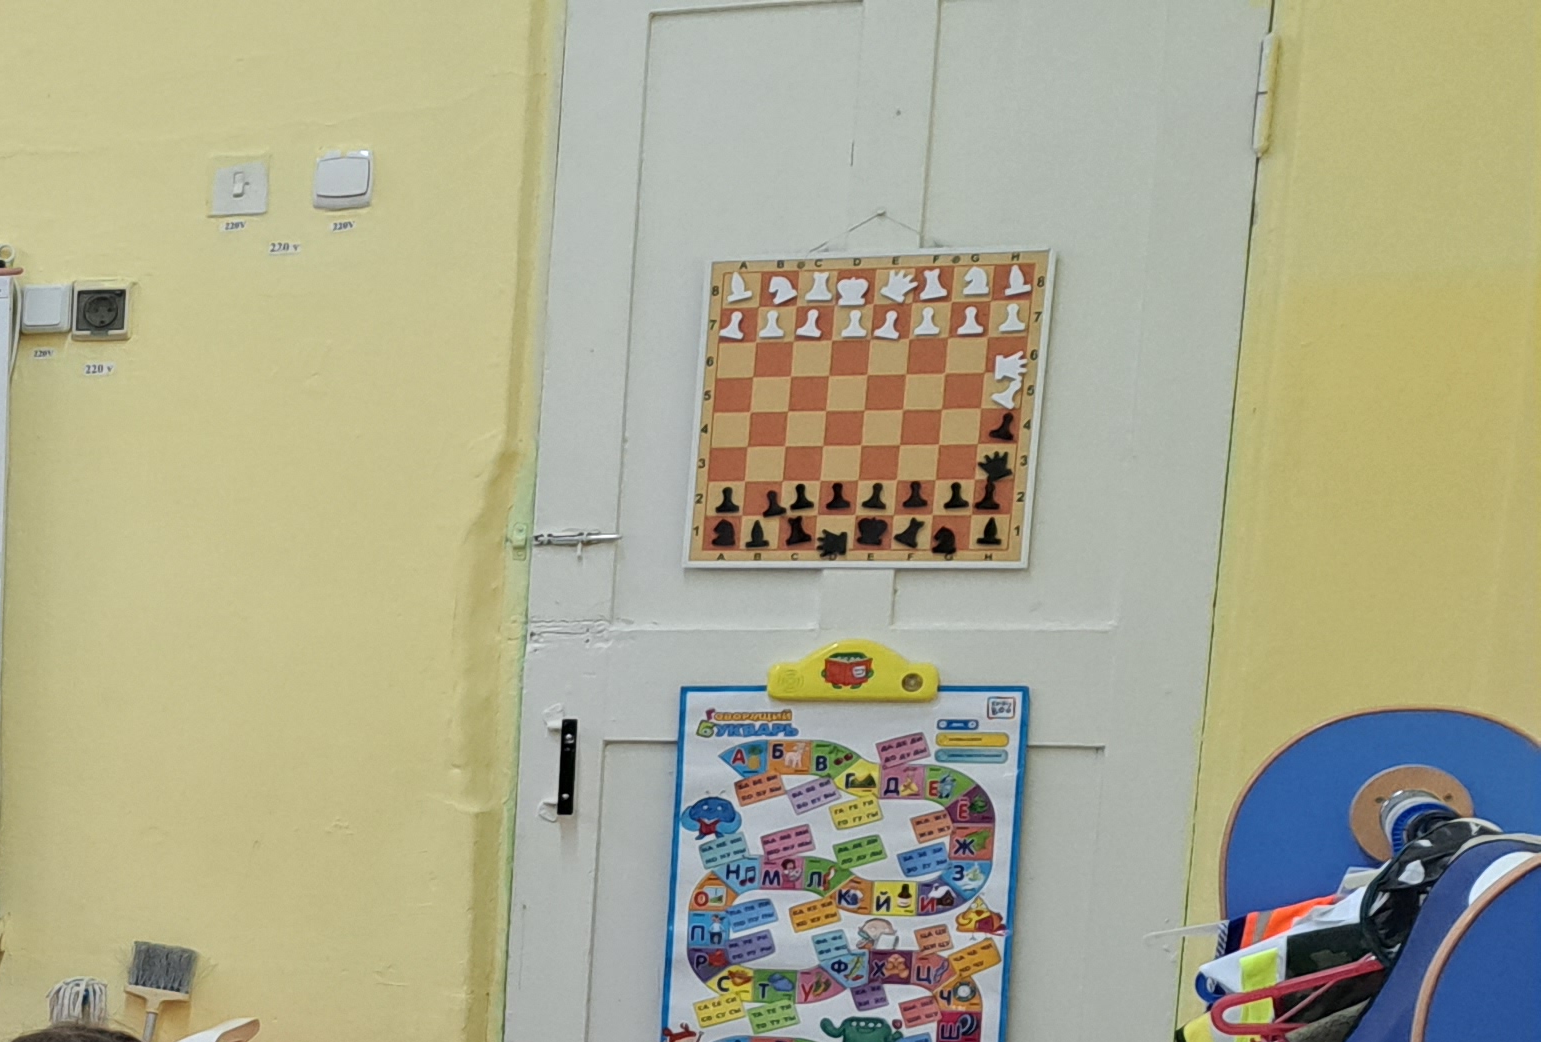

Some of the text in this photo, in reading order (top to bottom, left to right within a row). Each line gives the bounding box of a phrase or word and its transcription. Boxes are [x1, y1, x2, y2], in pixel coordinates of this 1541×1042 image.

[270, 242, 290, 253] 220
[739, 252, 1020, 270] A B C D E F G H
[1037, 276, 1045, 287] 8
[711, 286, 719, 296] 8
[709, 320, 717, 330] 7
[1035, 312, 1043, 322] 7
[706, 357, 714, 367] 6
[1030, 349, 1038, 360] 6
[85, 364, 104, 374] 220
[704, 391, 712, 401] 5
[1027, 385, 1035, 396] 5
[701, 424, 709, 433] 4
[1023, 419, 1031, 430] 4
[698, 458, 706, 468] 3
[1020, 455, 1028, 466] 3
[695, 494, 704, 504] 2
[1016, 492, 1025, 502] 2
[693, 526, 699, 536] 1
[1014, 526, 1020, 536] 1
[717, 553, 726, 561] A
[754, 553, 761, 561] B
[791, 553, 799, 561] C
[696, 719, 799, 738] БУКВАРЬ
[732, 748, 746, 765] А
[772, 743, 784, 759] Б
[815, 755, 828, 771] В
[884, 777, 900, 796] Д
[928, 780, 939, 797] Е
[958, 797, 970, 819] Ё
[953, 838, 975, 855] Ж
[726, 864, 740, 880] Н
[762, 870, 781, 886] М
[807, 871, 822, 887] Л
[952, 865, 964, 881] З
[694, 891, 709, 907] О
[837, 889, 849, 905] К
[875, 891, 891, 912] Й
[920, 896, 936, 912] И
[691, 925, 705, 941] П
[695, 955, 707, 969] Р
[830, 959, 848, 975] Ф
[872, 961, 886, 977] Х
[917, 966, 932, 984] Ц
[717, 976, 730, 992] С
[758, 983, 770, 999] Т
[801, 984, 814, 1002] У
[939, 990, 952, 1006] Ч
[941, 1024, 960, 1040] Ш
